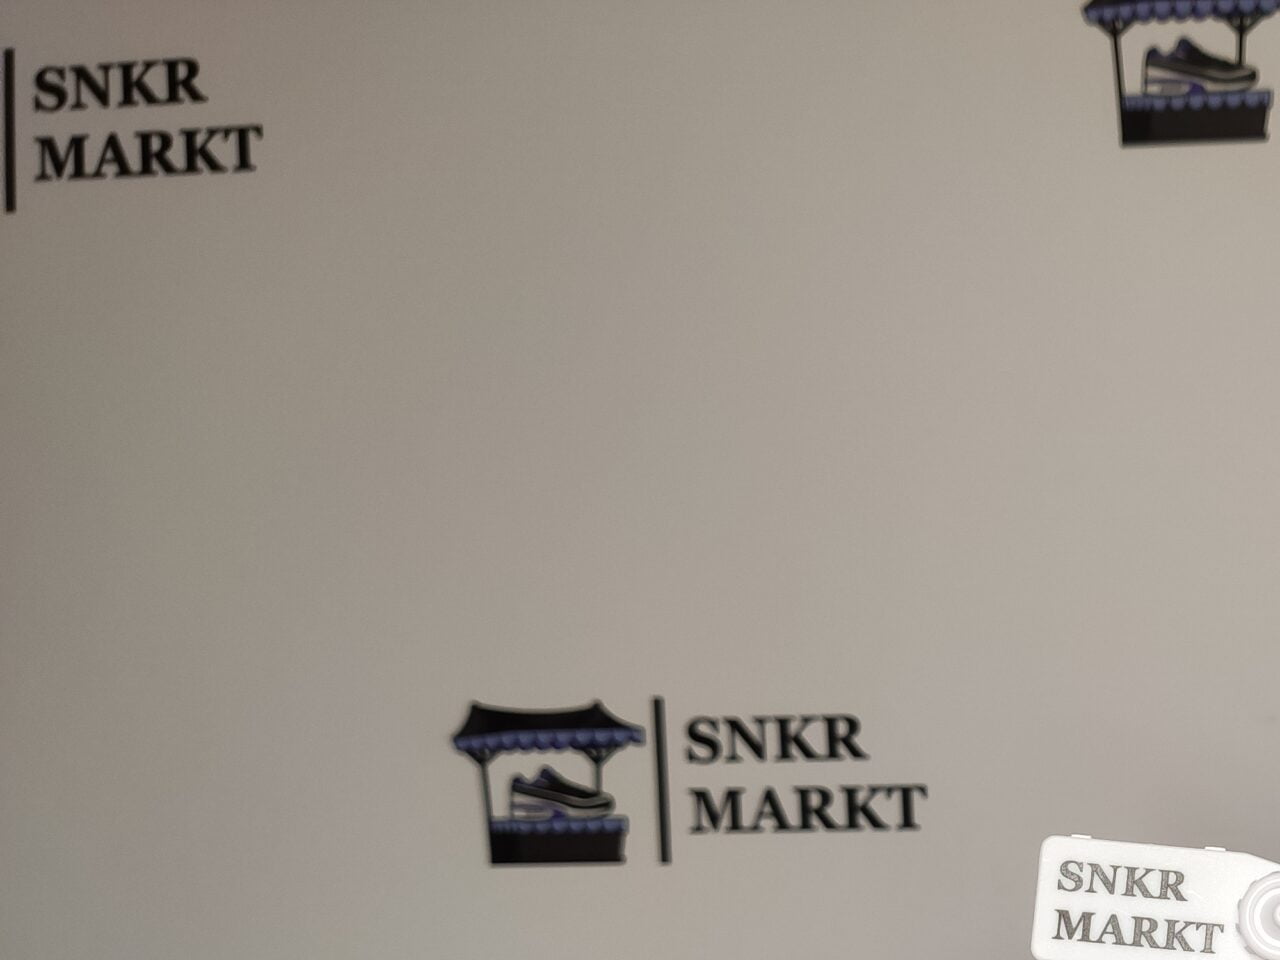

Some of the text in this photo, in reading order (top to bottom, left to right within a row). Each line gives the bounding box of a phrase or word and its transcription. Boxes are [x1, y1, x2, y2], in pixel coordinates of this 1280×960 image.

[33, 58, 209, 111] SNKR
[35, 126, 264, 181] MARKT
[685, 713, 869, 763] SNKR
[688, 784, 928, 834] MARKT
[1057, 860, 1186, 901] SNKR
[1052, 909, 1224, 954] MARKT
